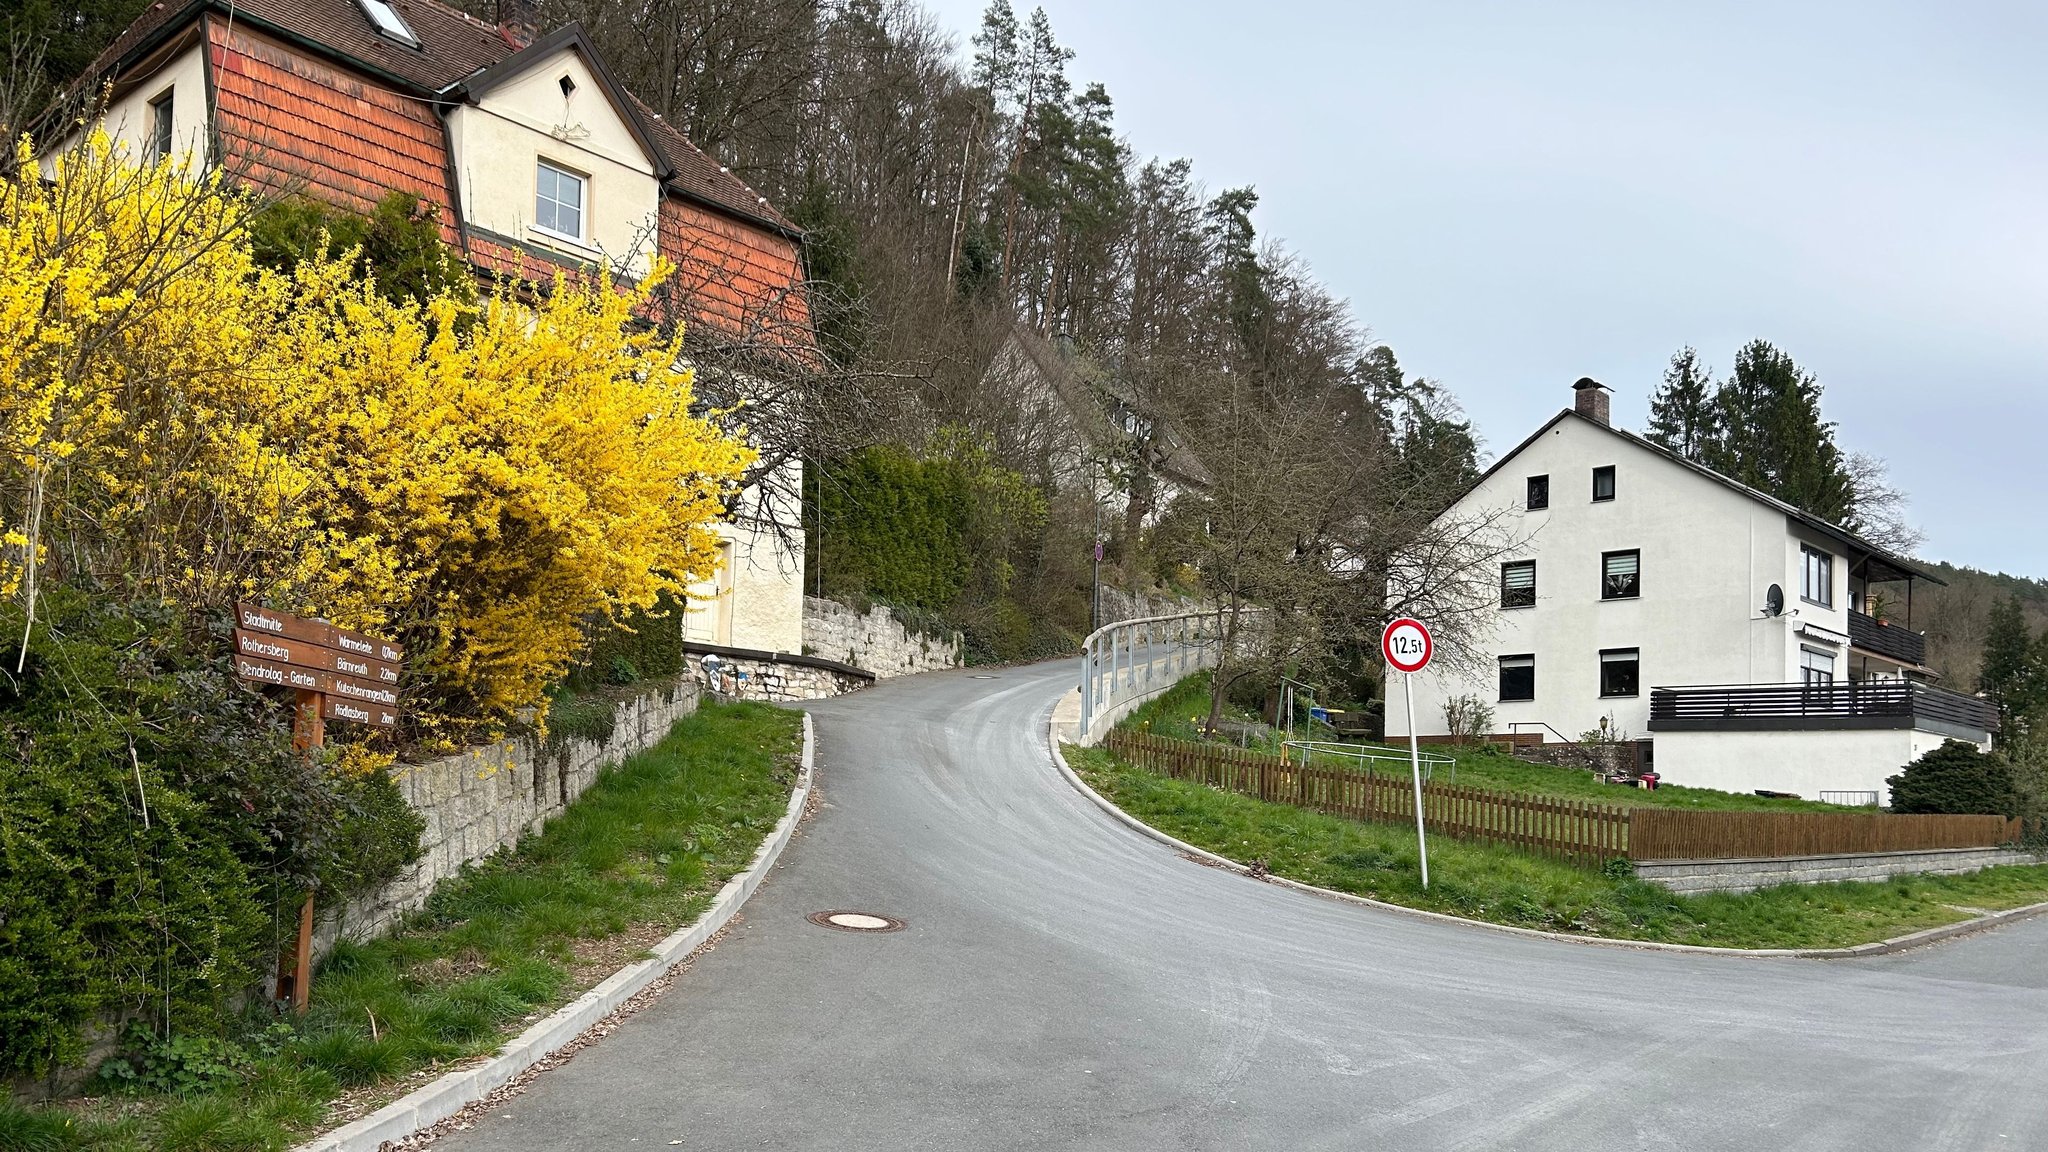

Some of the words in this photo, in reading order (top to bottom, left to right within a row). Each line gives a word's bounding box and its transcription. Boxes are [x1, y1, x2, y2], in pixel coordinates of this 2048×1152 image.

[243, 611, 283, 632] Stadtmitte
[241, 636, 289, 662] Rothersberg
[337, 657, 368, 675] Bärnreuth
[290, 670, 316, 687] Garten
